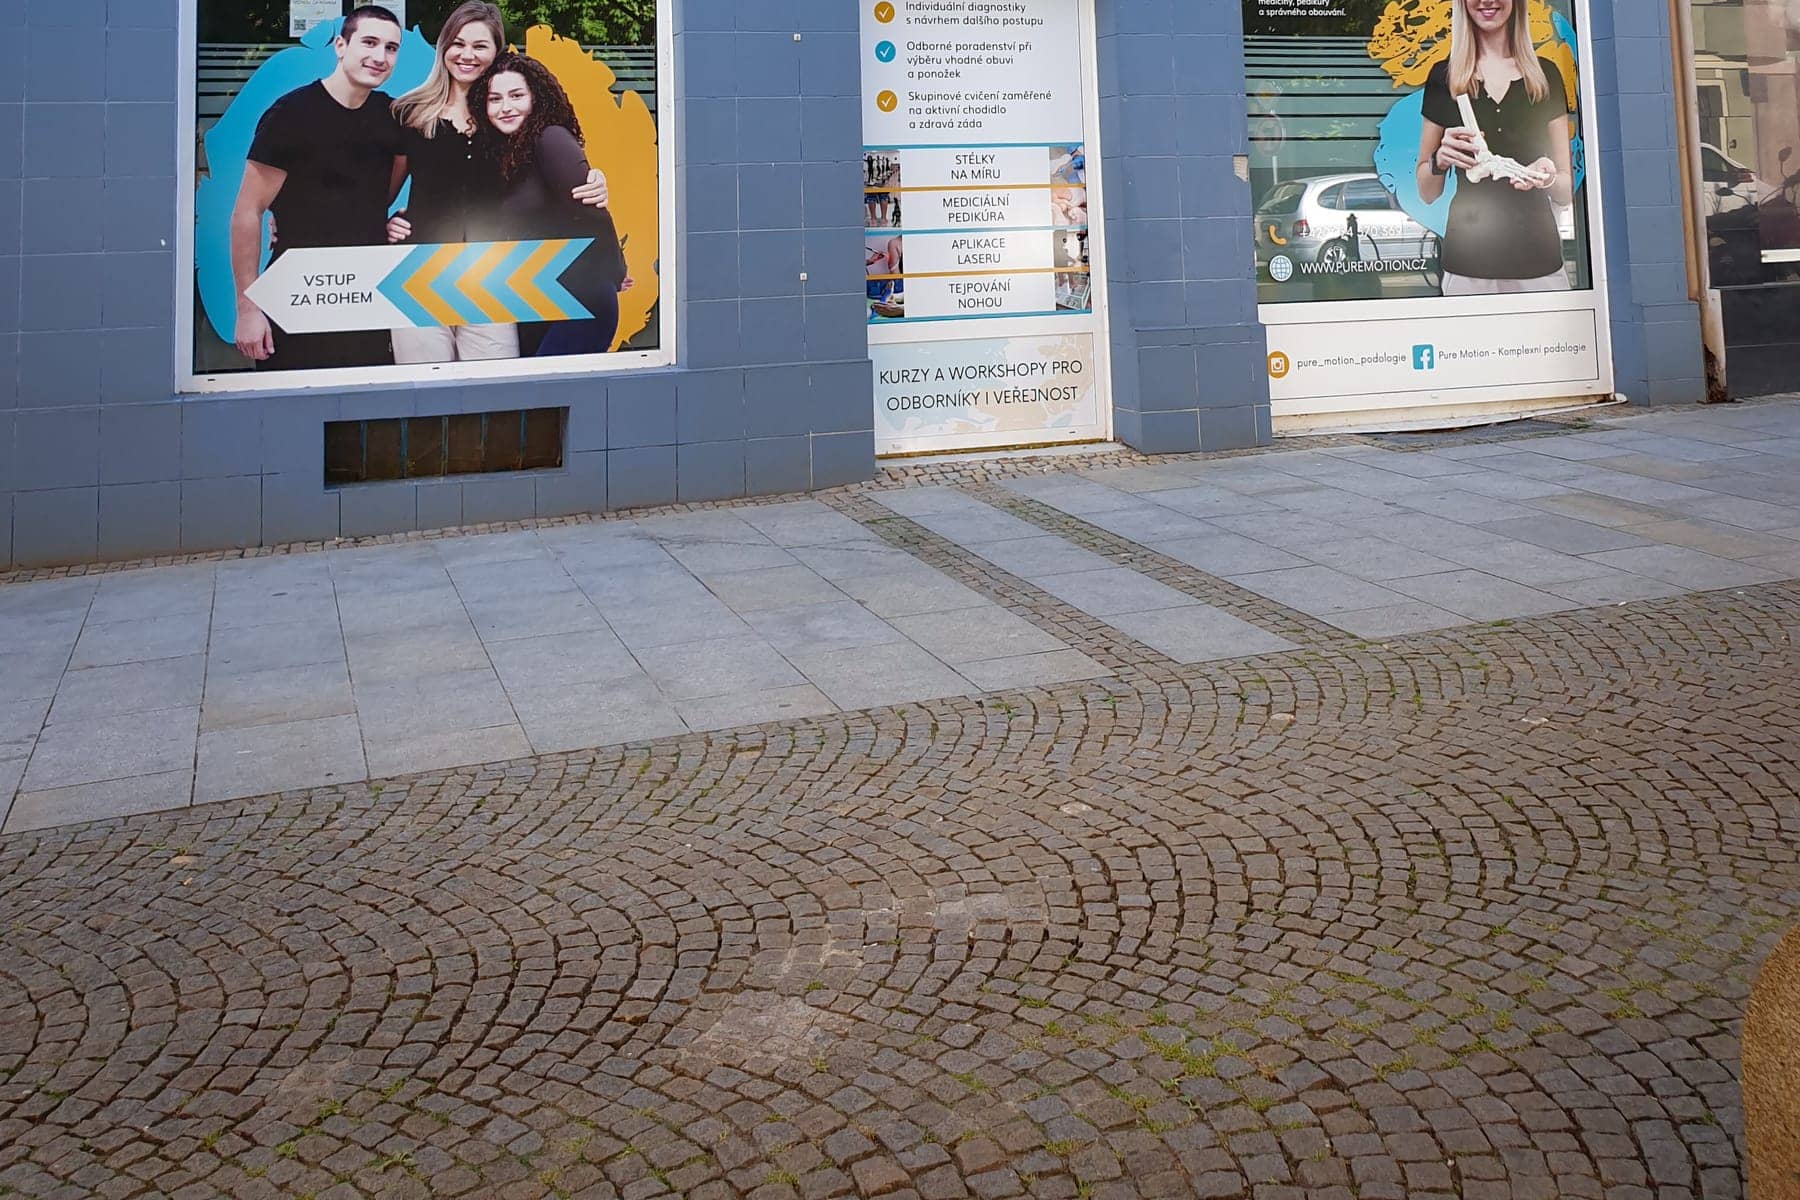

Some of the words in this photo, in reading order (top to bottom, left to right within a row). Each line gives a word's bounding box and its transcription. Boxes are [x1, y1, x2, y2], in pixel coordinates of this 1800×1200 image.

[905, 1, 966, 12] Individuální
[968, 2, 1026, 14] diagnostiky
[1266, 7, 1307, 17] správného
[1308, 7, 1347, 16] obouvání.
[906, 17, 912, 25] s
[914, 15, 960, 25] návrhem
[963, 15, 999, 25] dalšího
[1002, 17, 1044, 27] postupu
[906, 41, 952, 51] Odborné
[955, 41, 1017, 52] poradenství
[1019, 42, 1032, 53] při
[907, 54, 942, 66] výběru
[945, 54, 983, 65] vhodné
[986, 55, 1014, 65] obuvi
[907, 70, 914, 78] a
[917, 68, 961, 80] ponožek
[908, 91, 961, 102] Skupinové
[964, 90, 999, 101] cvičení
[1002, 90, 1052, 101] zaměřené
[909, 107, 922, 115] na
[925, 104, 960, 115] aktivní
[963, 105, 1007, 114] chodidlo
[909, 121, 916, 129] a
[919, 118, 954, 129] zdravá
[957, 118, 982, 128] záda
[955, 152, 995, 165] STÉLKY
[951, 170, 968, 180] NA
[971, 167, 1001, 180] MÍRU
[942, 193, 1010, 208] MEDICIÁLNÍ
[948, 209, 1005, 223] PEDIKÚRA
[951, 237, 1006, 250] APLIKACE
[957, 253, 1001, 265] LASERU
[1300, 259, 1428, 274] WWW.PUREMOTION.CZ
[303, 273, 356, 287] VSTUP
[949, 279, 1011, 295] TEJPOVÁNÍ
[290, 293, 312, 306] ZA
[316, 291, 373, 305] ROHEM
[958, 297, 1003, 309] NOHOU
[1438, 350, 1458, 361] Pure
[1460, 348, 1490, 360] Motion
[1498, 345, 1541, 359] Komplexní
[1544, 342, 1586, 355] podologie
[1297, 352, 1407, 369] pure_motion_podologie
[879, 368, 930, 385] KURZY
[934, 367, 945, 381] A
[949, 361, 1048, 381] WORKSHOPY
[1052, 360, 1083, 374] PRO
[887, 389, 981, 411] ODBORNÍKY
[993, 385, 1079, 405] VEŘEJNOST
